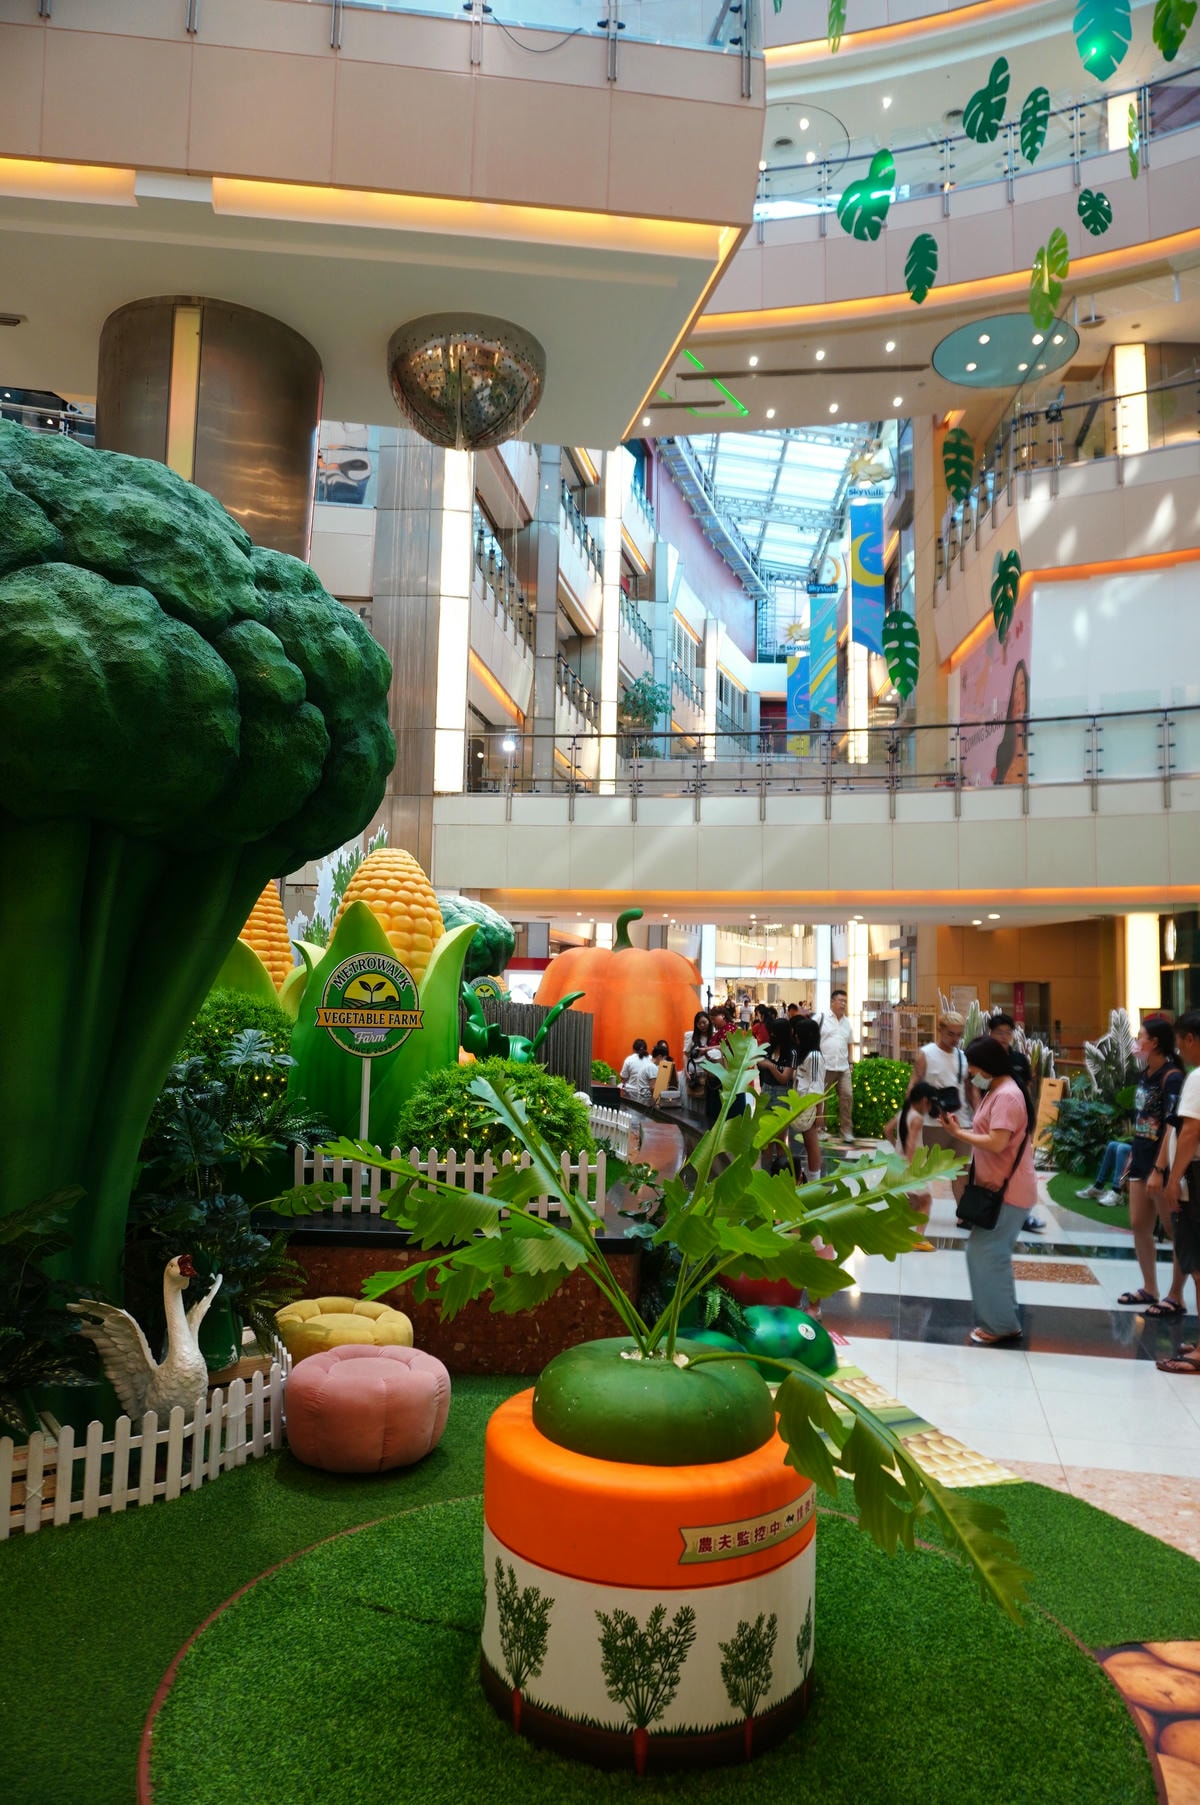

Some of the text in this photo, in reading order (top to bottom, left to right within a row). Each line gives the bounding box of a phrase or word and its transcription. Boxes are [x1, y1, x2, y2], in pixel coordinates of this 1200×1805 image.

[332, 957, 411, 991] METROWALK
[323, 1011, 418, 1026] VEGETABLE FARM
[354, 1031, 387, 1044] Farm
[347, 1043, 371, 1054] SINCE
[698, 1520, 780, 1553] 農夫監控中
